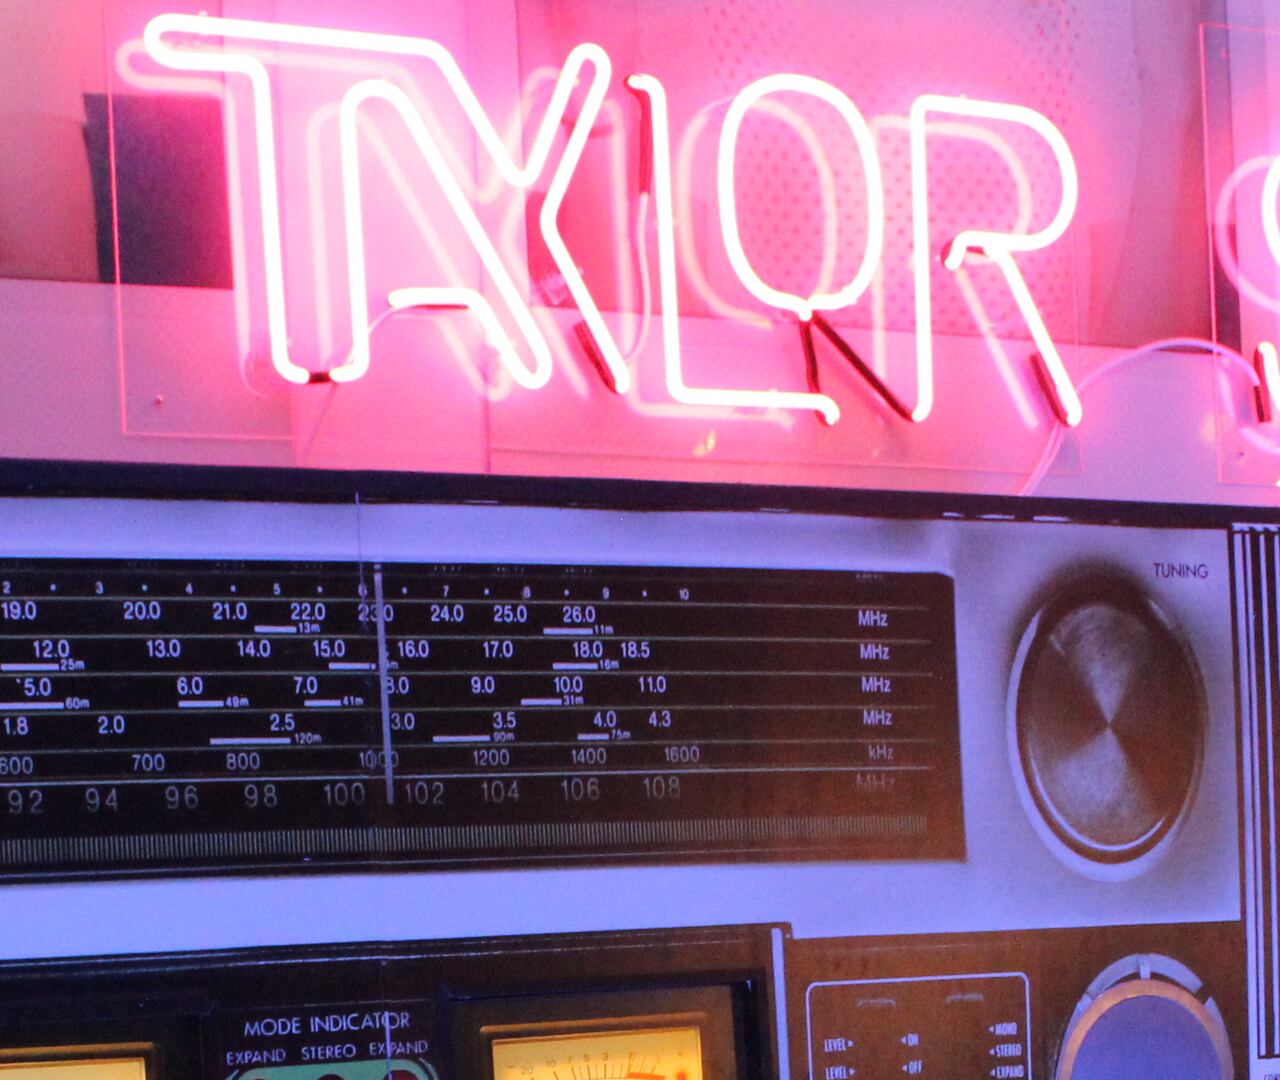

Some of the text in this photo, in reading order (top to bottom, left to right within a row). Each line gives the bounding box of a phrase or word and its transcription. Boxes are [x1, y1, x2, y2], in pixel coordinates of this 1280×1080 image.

[144, 10, 1082, 428] TAYLOR
[1153, 563, 1208, 579] TUNING
[3, 581, 11, 593] 2
[96, 583, 103, 593] 3
[185, 583, 192, 593] 4
[274, 584, 280, 594] 5
[443, 586, 449, 596] 7
[603, 588, 609, 599] 9
[680, 589, 689, 600] 10
[1, 603, 36, 620] 19.0
[124, 602, 160, 620] 20.0
[213, 603, 247, 620] 21.0
[291, 603, 325, 621] 22.0
[430, 605, 464, 622] 24.0
[493, 605, 527, 623] 25.0
[563, 605, 596, 623] 26.0
[858, 611, 888, 626] MHz
[33, 640, 69, 658] 12.0
[147, 640, 181, 658] 13.0
[238, 641, 271, 658] 14.0
[313, 641, 345, 658] 15.0
[398, 641, 429, 658] 16.0
[483, 641, 513, 658] 17.0
[572, 641, 603, 658] 18.0
[621, 641, 650, 658] 18.5
[860, 644, 889, 659] MHz
[24, 678, 51, 696] 5.0
[177, 677, 203, 695] 6.0
[294, 677, 318, 694] 7.0
[471, 677, 495, 694] 9.0
[554, 677, 583, 694] 10.0
[638, 676, 666, 693] 11.0
[862, 677, 892, 692] MHz
[4, 718, 28, 736] 1.8
[98, 716, 125, 734] 2.0
[270, 714, 295, 731] 2.5
[391, 713, 415, 730] 3.0
[493, 712, 516, 729] 3.5
[593, 711, 616, 728] 4.0
[648, 711, 671, 727] 4.3
[863, 710, 892, 725] MHz
[132, 754, 165, 772] 700
[226, 753, 260, 770] 800
[473, 749, 509, 766] 1200
[571, 748, 607, 765] 1400
[664, 746, 699, 763] 1600
[869, 745, 894, 759] kHz
[8, 790, 44, 814] 92
[85, 789, 119, 812] 94
[166, 785, 198, 810] 96
[244, 784, 277, 808] 98
[323, 782, 365, 806] 100
[405, 781, 445, 805] 102
[482, 780, 520, 803] 104
[561, 779, 600, 801] 106
[643, 776, 680, 799] 108
[244, 1012, 410, 1037] MODE INDICATOR
[302, 1044, 356, 1060] STEREO
[370, 1040, 428, 1055] EXPAND
[824, 1038, 846, 1053] LEVEL
[996, 1044, 1022, 1057] STEREO
[226, 1049, 285, 1066] EXPAND
[826, 1066, 847, 1080] LEVEL
[908, 1060, 922, 1074] OFF
